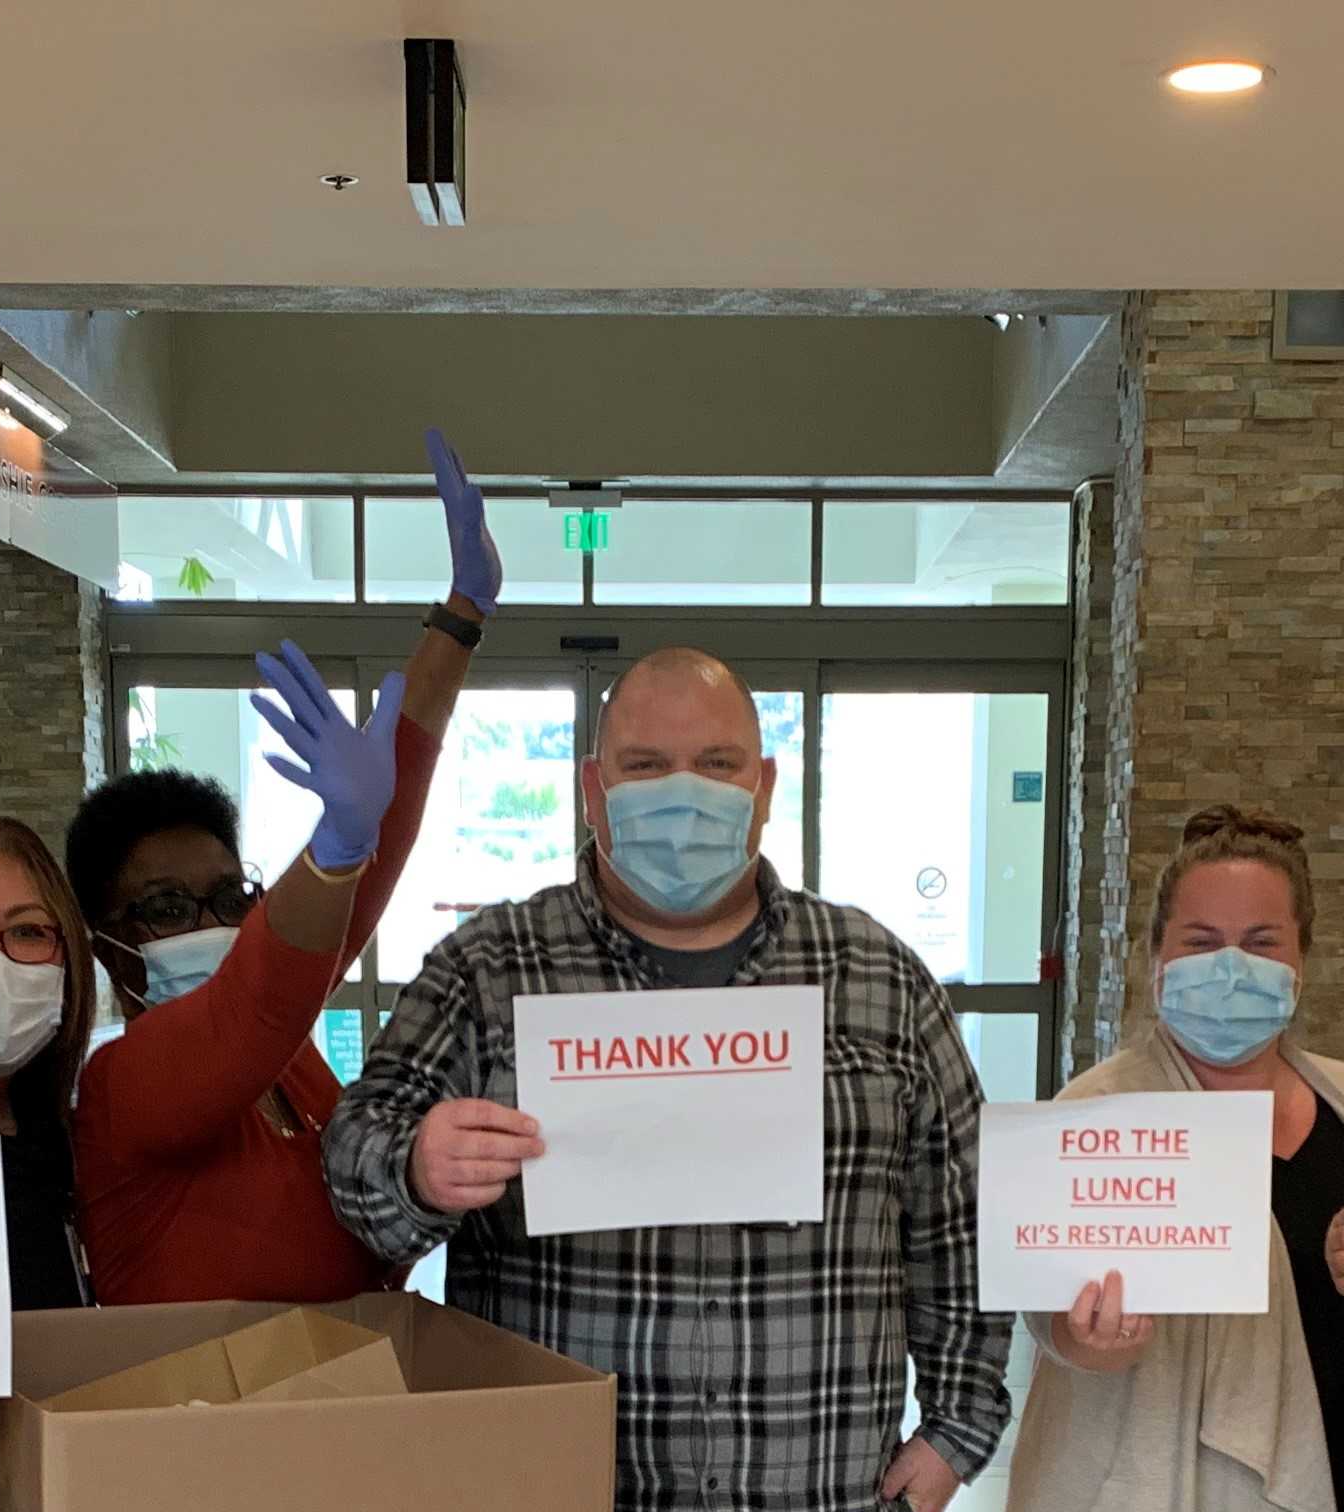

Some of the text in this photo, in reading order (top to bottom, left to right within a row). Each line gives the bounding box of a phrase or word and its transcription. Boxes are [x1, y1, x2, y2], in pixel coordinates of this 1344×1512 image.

[564, 511, 611, 550] EXIT
[551, 1031, 789, 1072] THANK YOU
[1060, 1128, 1190, 1154] FOR THE
[1071, 1176, 1176, 1202] LUNCH
[1015, 1223, 1233, 1246] KI'S RESTAURANT
